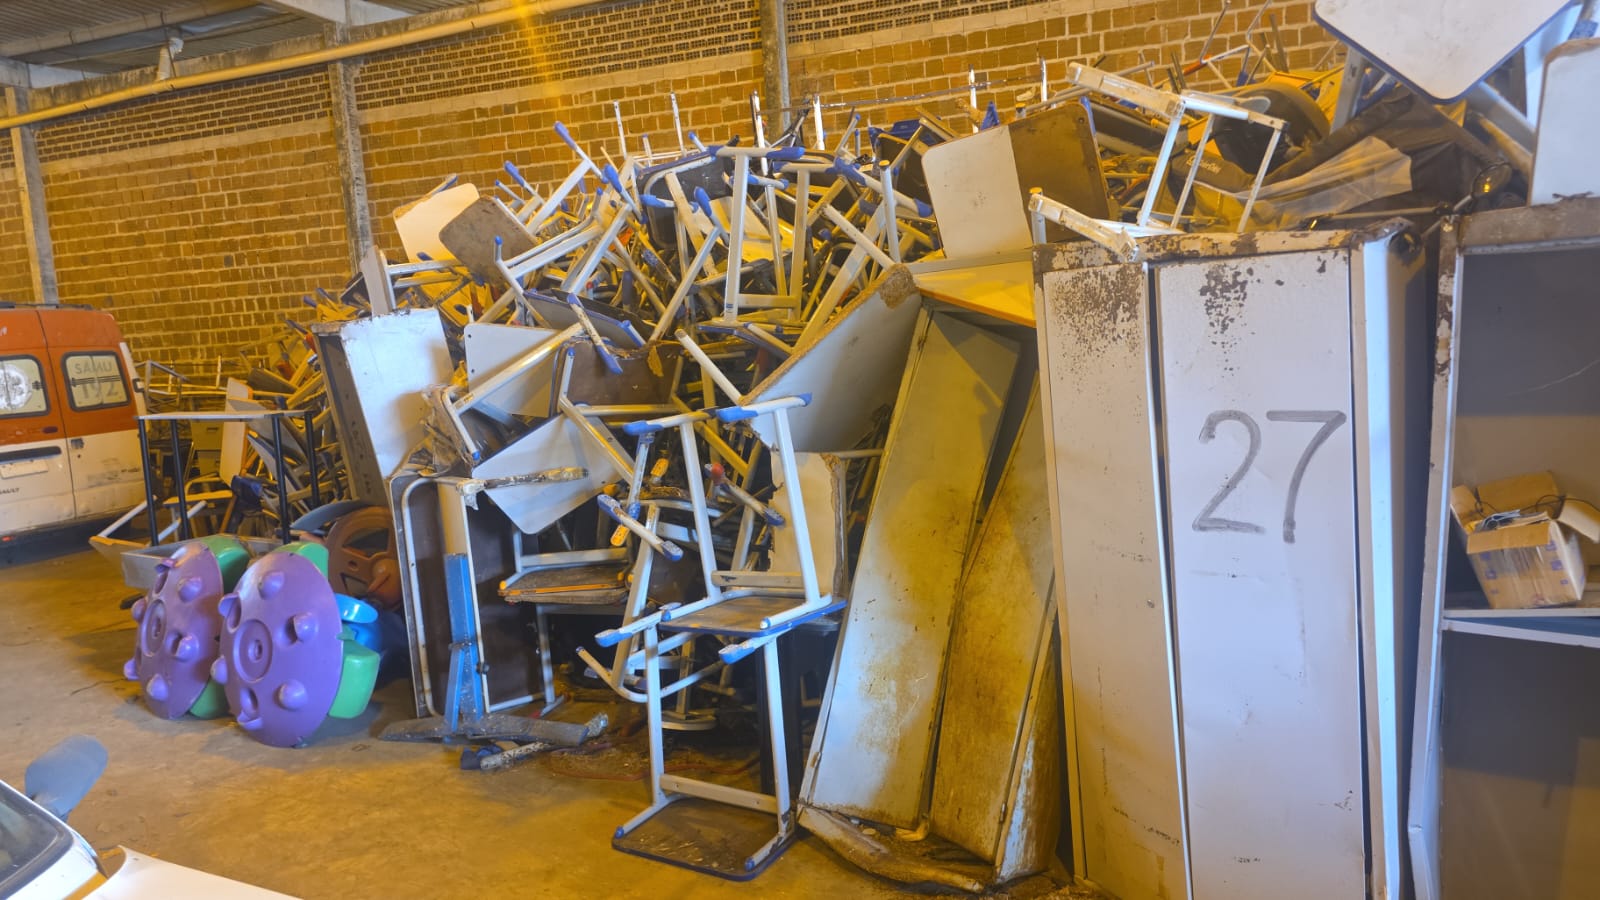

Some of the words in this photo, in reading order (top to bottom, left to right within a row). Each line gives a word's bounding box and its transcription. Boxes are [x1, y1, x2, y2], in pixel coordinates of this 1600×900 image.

[74, 361, 113, 374] SAMU
[81, 378, 119, 399] 192
[1192, 409, 1347, 544] 27
